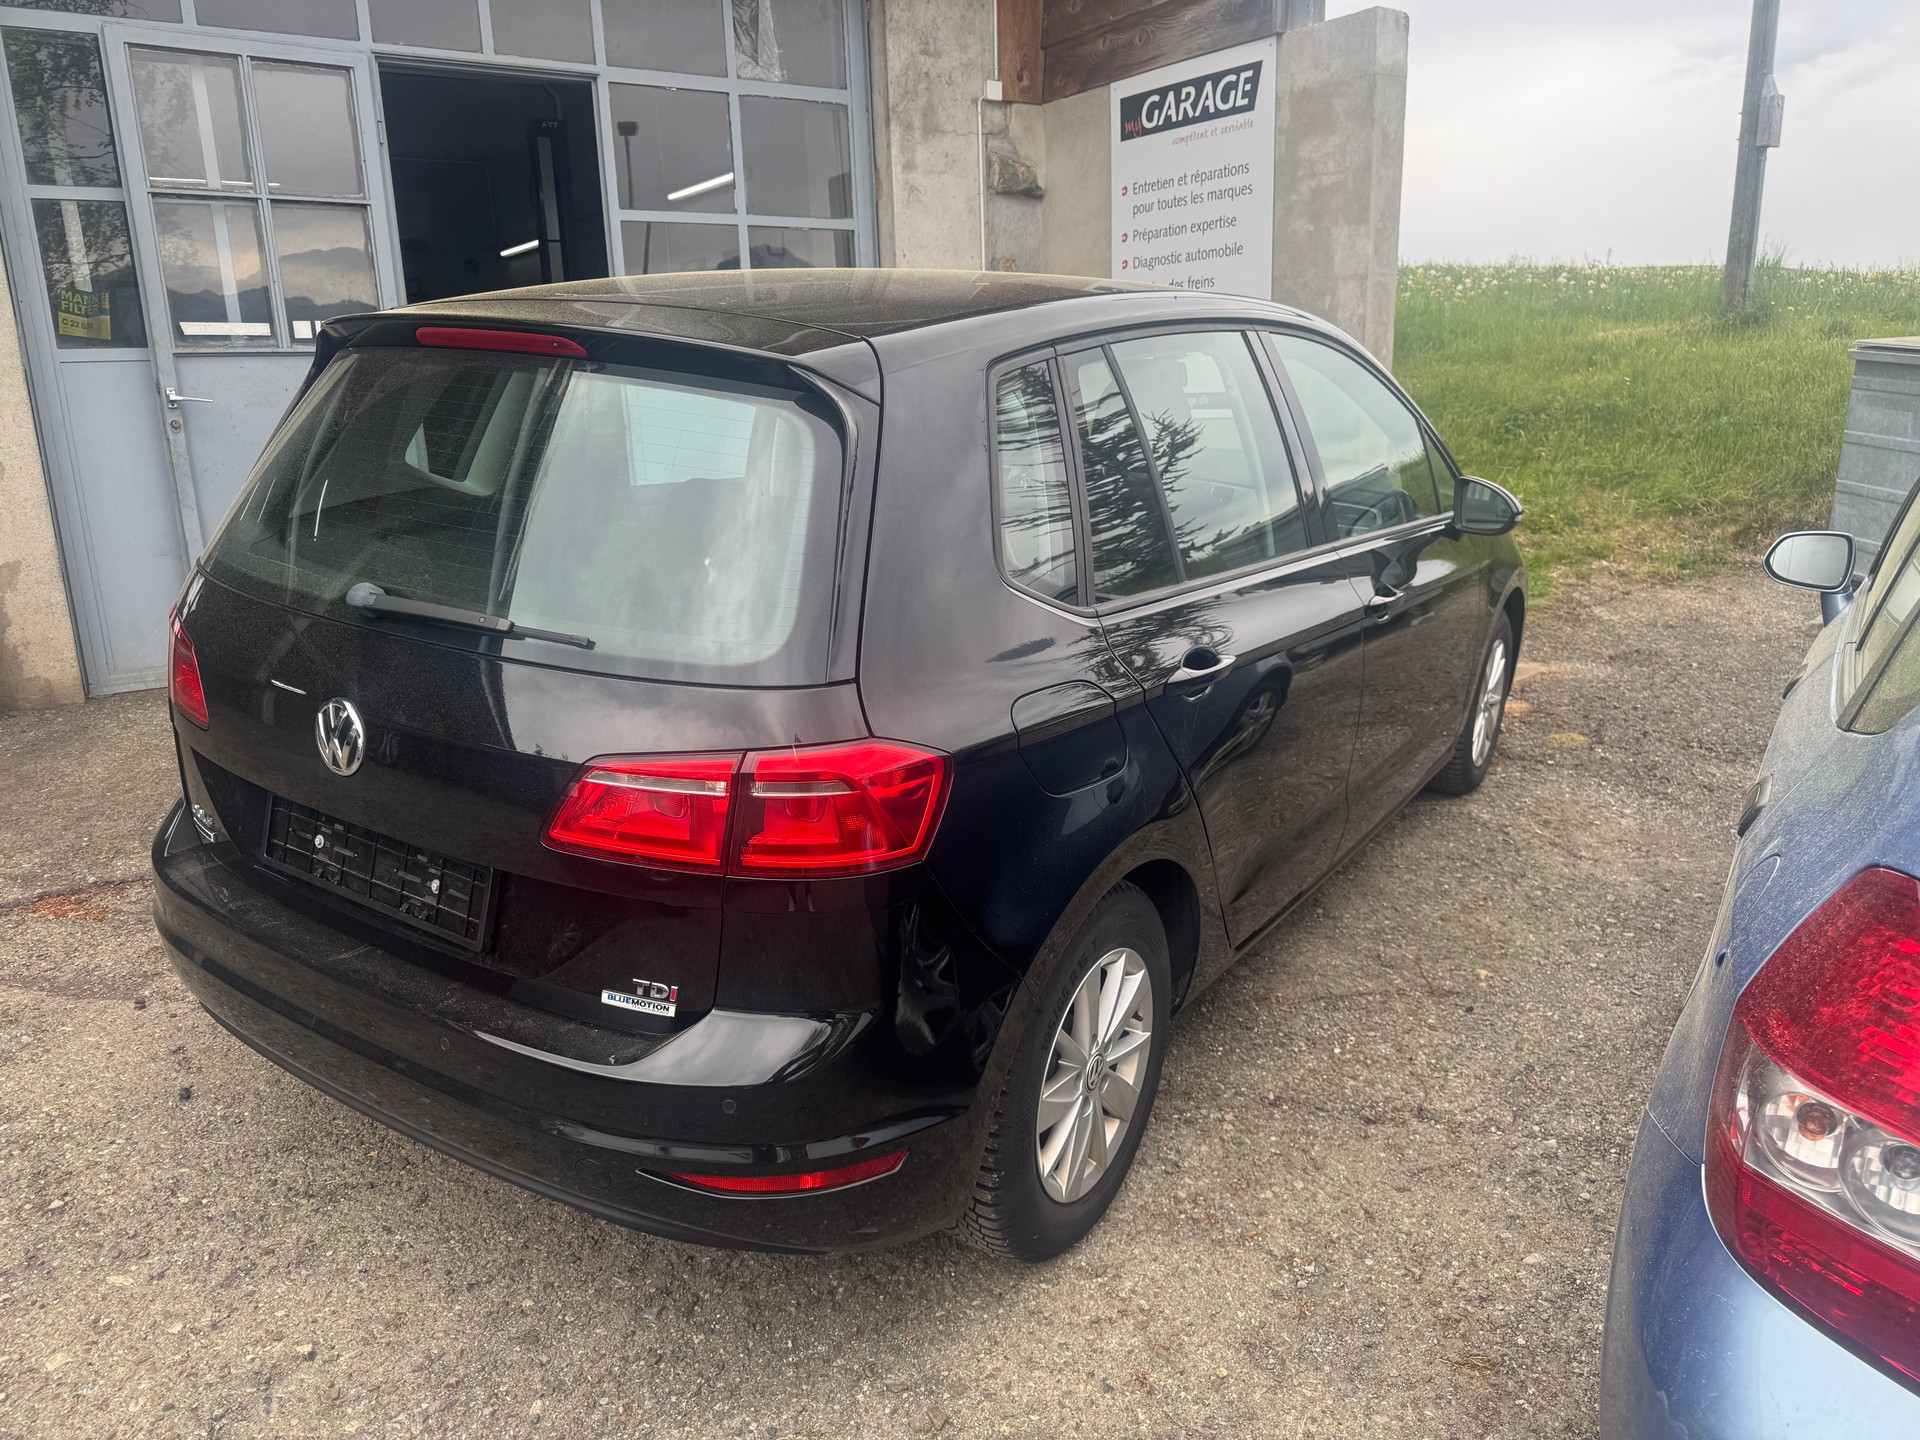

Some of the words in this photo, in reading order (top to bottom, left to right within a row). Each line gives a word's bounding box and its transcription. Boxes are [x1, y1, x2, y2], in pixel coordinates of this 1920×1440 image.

[1172, 130, 1208, 146] compétent
[1211, 127, 1218, 136] et
[1220, 118, 1254, 135] serviable
[1133, 177, 1174, 195] Entretien
[1177, 172, 1187, 187] et
[1190, 163, 1250, 187] réparations
[1133, 201, 1155, 219] pour
[1158, 195, 1188, 211] toutes
[1190, 191, 1204, 205] les
[1207, 183, 1253, 202] marques
[1133, 223, 1187, 244] Préparation
[1190, 215, 1237, 236] expertise
[1133, 251, 1182, 271] Diagnostic
[1185, 241, 1244, 263] automobile
[1187, 276, 1215, 289] freins
[61, 289, 99, 305] MANN
[61, 300, 99, 315] FILTER
[70, 320, 80, 329] 22
[632, 978, 678, 1002] TDI
[607, 993, 670, 1012] BLUEMOTION
